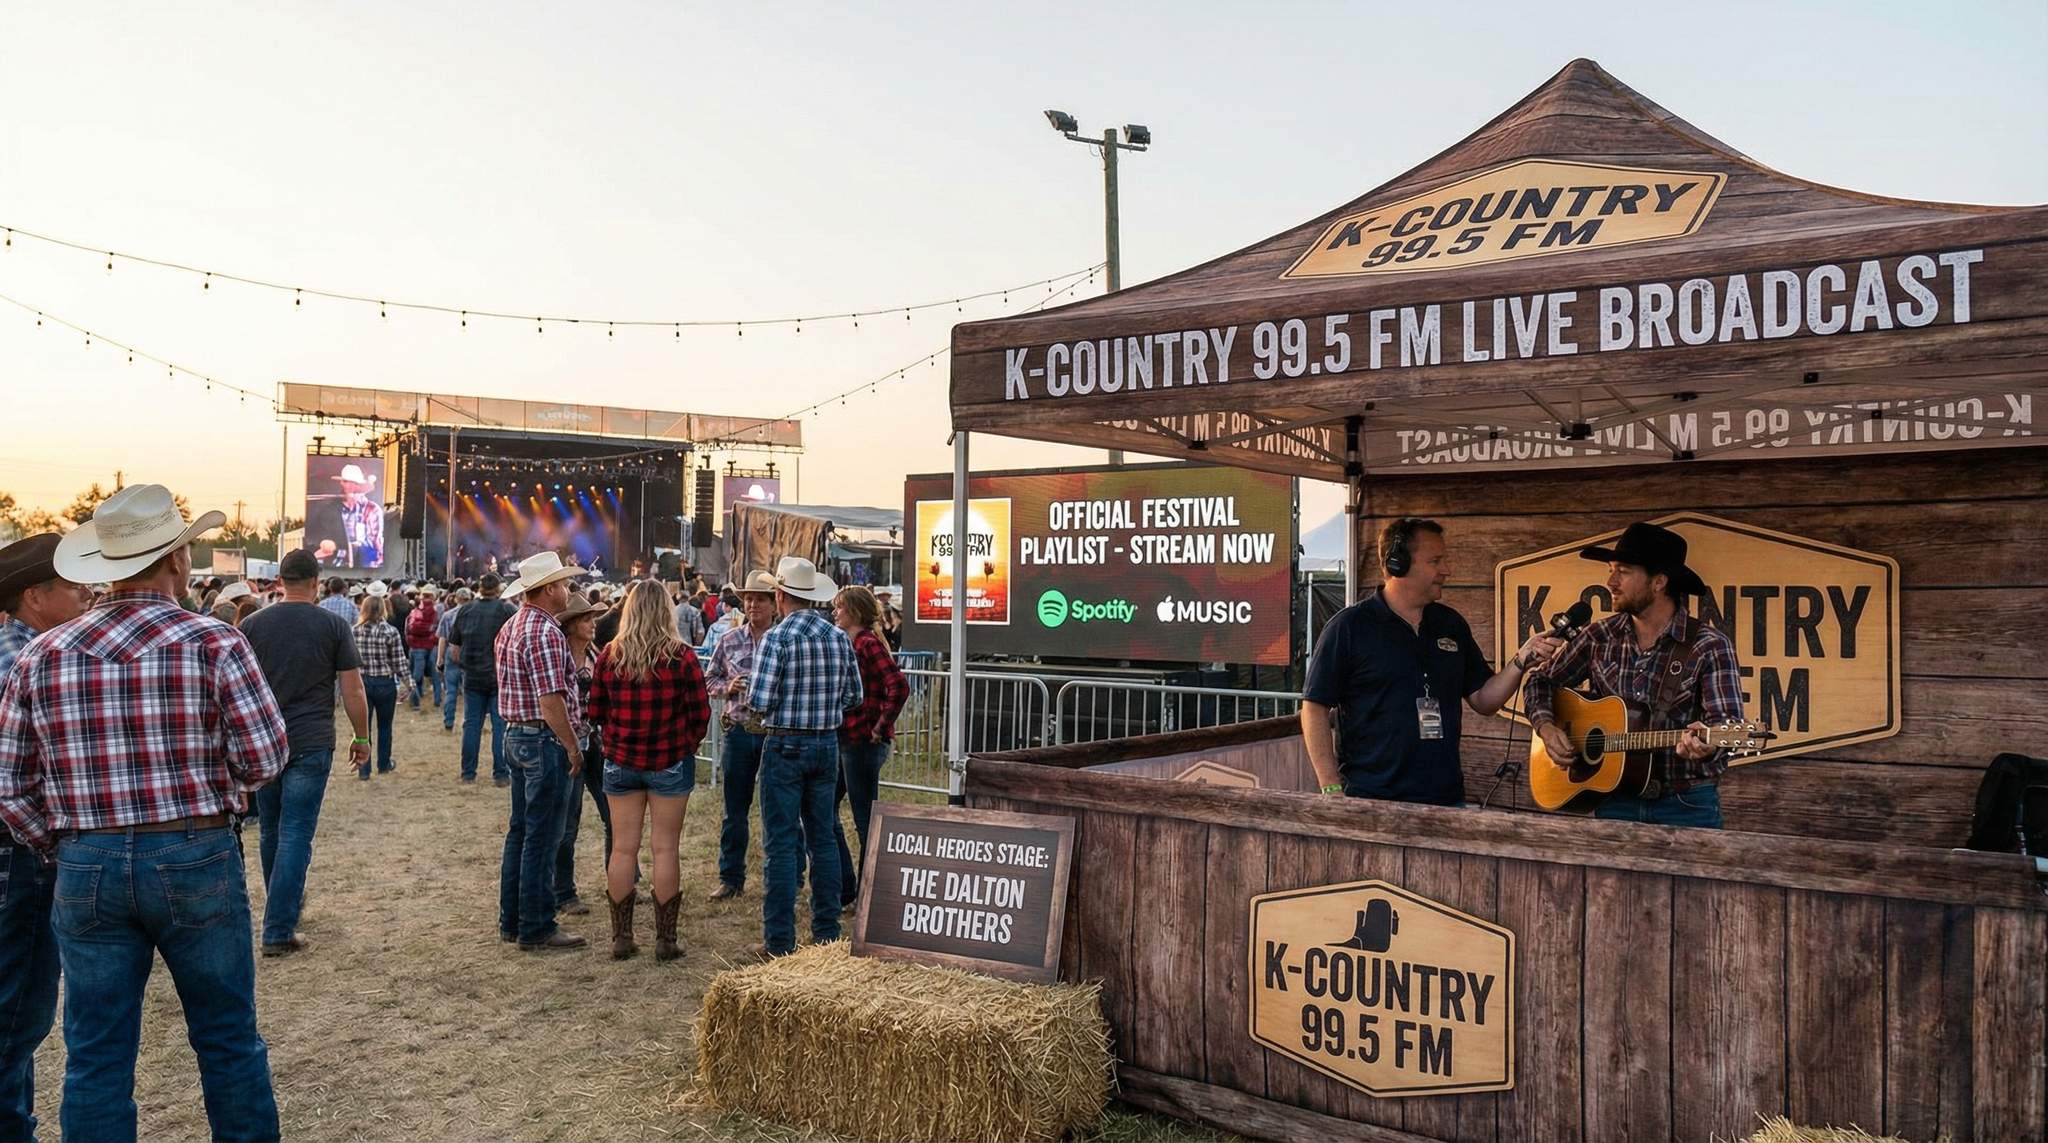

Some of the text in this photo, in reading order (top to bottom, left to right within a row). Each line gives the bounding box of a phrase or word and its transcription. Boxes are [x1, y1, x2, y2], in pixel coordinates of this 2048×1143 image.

[1326, 181, 1700, 251] K-COUNTRY
[1361, 218, 1605, 269] 99.5 FM
[1004, 249, 1984, 401] K-COUNTRY 99.5 FM LIVE BROADCAST
[1049, 496, 1240, 531] OFFICIAL FESTIVAL
[1020, 536, 1109, 565] PLAYLIST
[1130, 534, 1215, 565] STREAM
[1222, 533, 1275, 563] NOW
[1071, 599, 1252, 625] Spotify MUSIC
[887, 832, 1050, 869] LOCAL HEROES STAGE:
[900, 867, 1026, 910] THE DALTON
[902, 903, 1013, 945] BROTHERS
[1265, 940, 1495, 1026] K-COUNTRY
[1301, 1003, 1453, 1078] 99.5 FM
